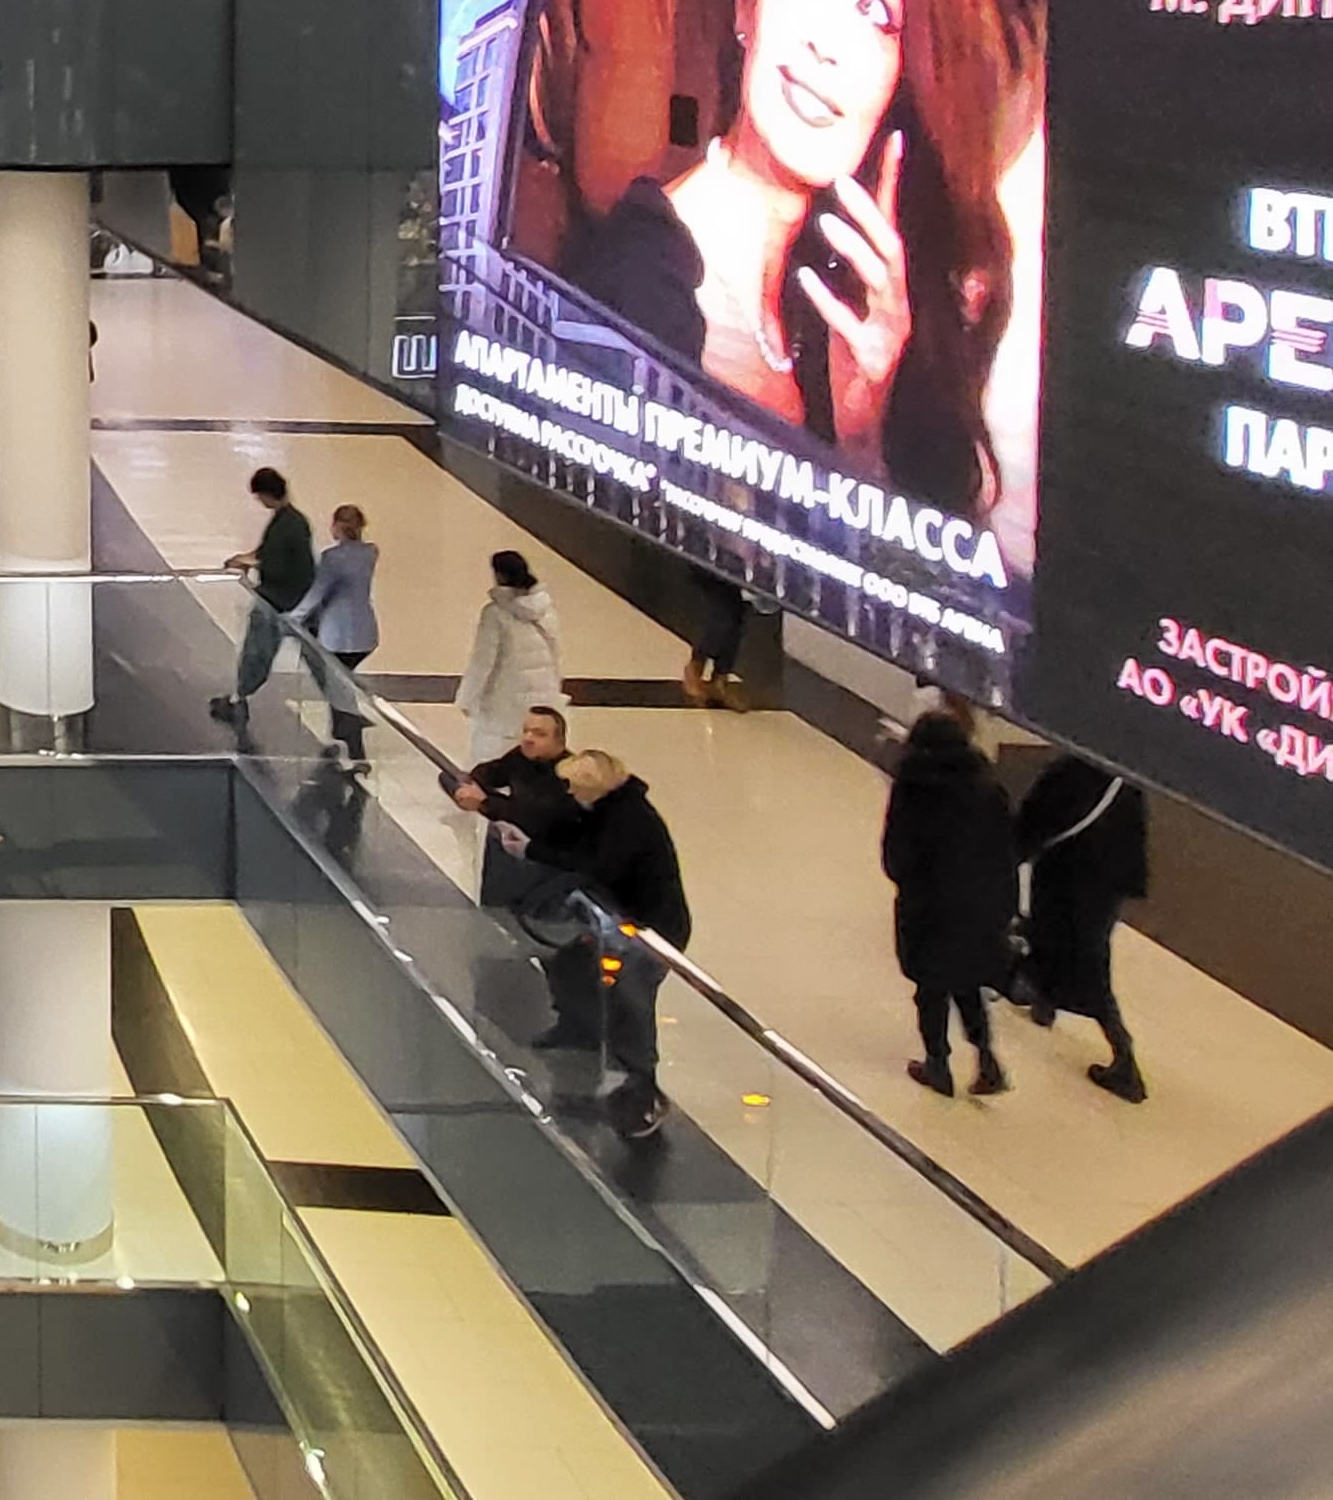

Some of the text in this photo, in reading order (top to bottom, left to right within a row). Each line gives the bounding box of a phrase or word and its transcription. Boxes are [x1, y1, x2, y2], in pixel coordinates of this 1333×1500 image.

[1247, 187, 1333, 262] ВТ
[1124, 266, 1333, 392] АРЕ
[454, 329, 640, 436] АПАРТАМЕНТЫ
[644, 401, 1009, 589] ПРЕМИУМ-КЛАССА
[1116, 657, 1177, 706] АО
